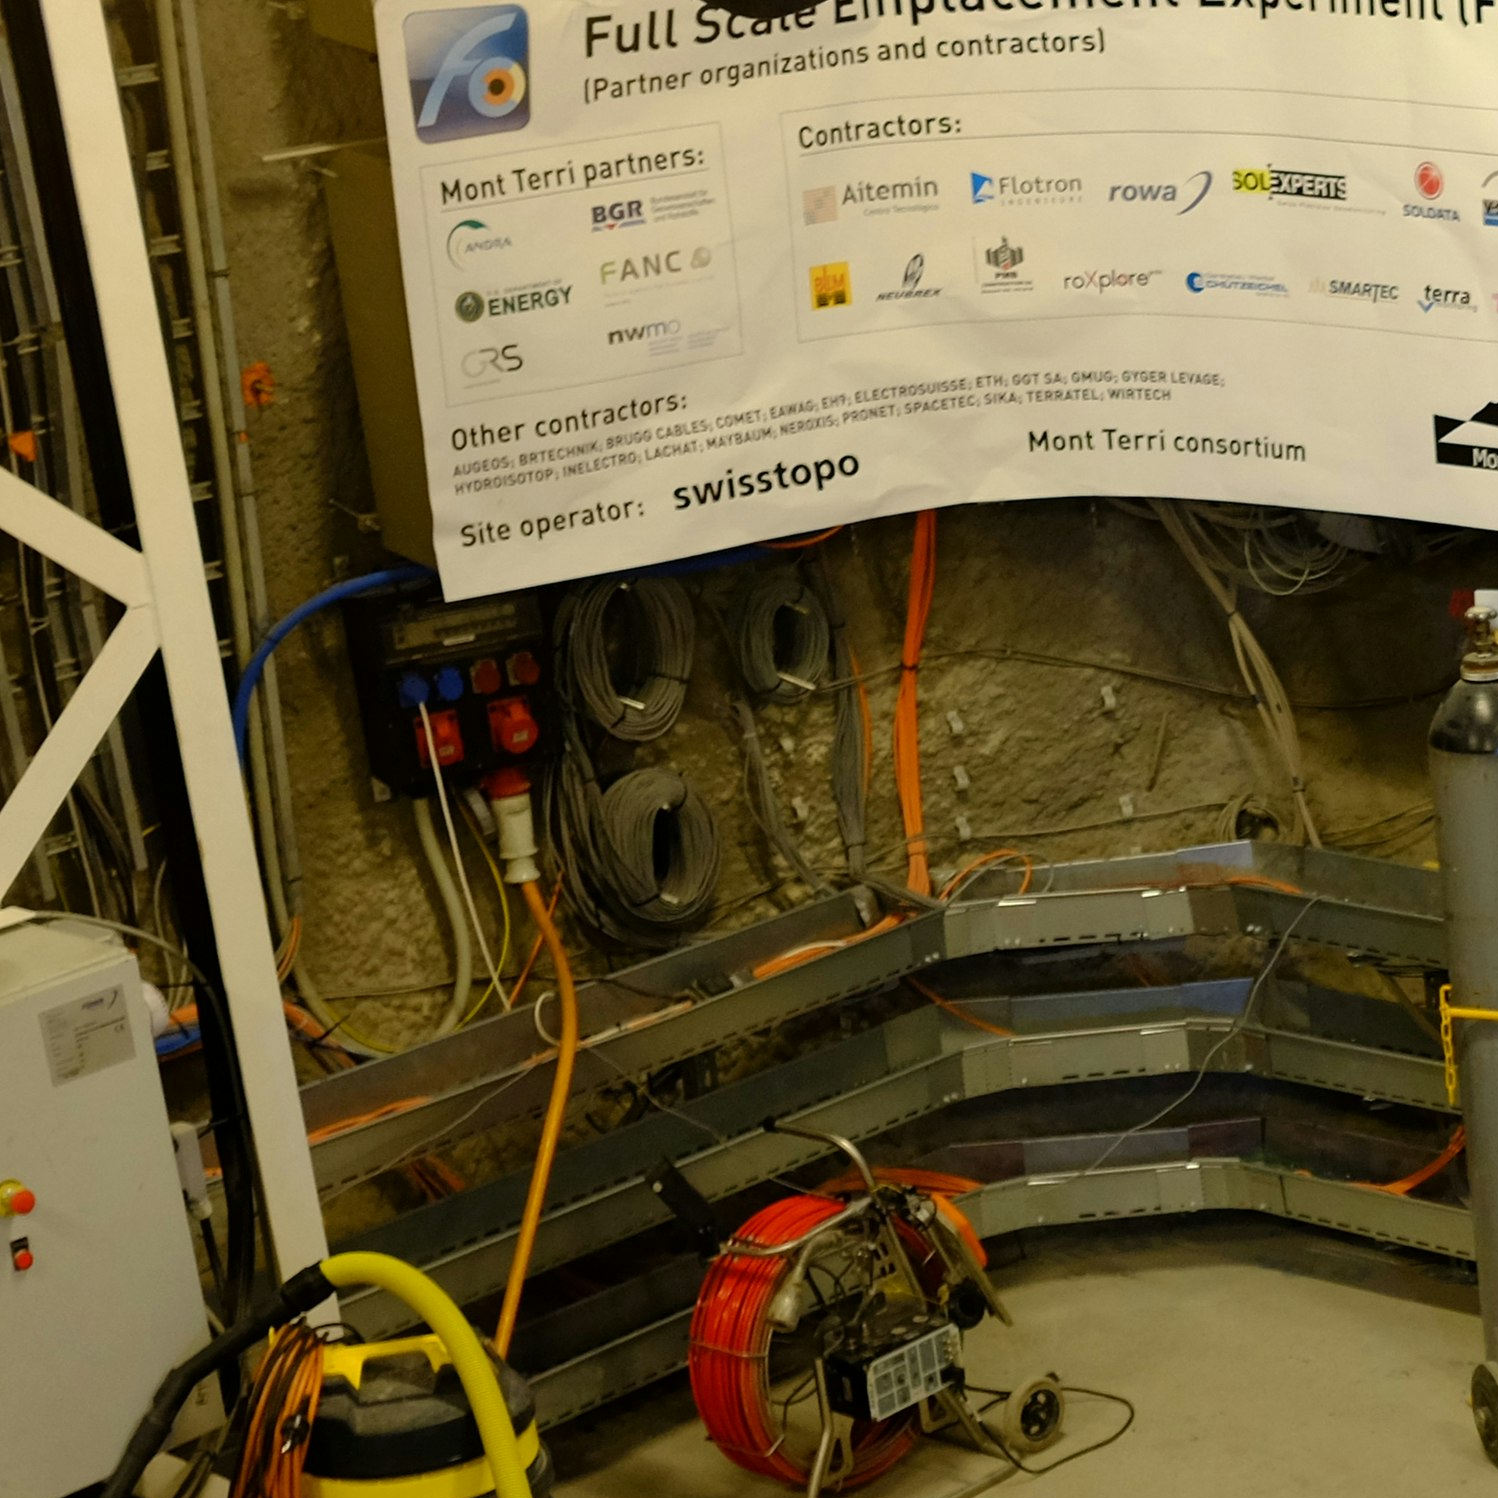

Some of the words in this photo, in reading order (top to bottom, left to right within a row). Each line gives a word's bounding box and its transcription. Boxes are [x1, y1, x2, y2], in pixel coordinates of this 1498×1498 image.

[585, 8, 677, 57] Full
[584, 70, 692, 104] (Partner
[700, 47, 868, 87] organizations
[877, 36, 925, 61] and
[937, 28, 1105, 59] contractors)
[799, 115, 962, 149] Contractors:
[441, 174, 505, 205] Mont
[512, 161, 575, 193] Terri
[583, 148, 705, 188] partners:
[842, 176, 939, 205] Aitemin
[1000, 176, 1082, 195] Flotron
[1233, 170, 1347, 200] SOLEXPERTS
[1108, 184, 1177, 202] rowa
[592, 200, 643, 225] BGR
[600, 250, 682, 285] FANC
[488, 285, 573, 317] ENERGY
[1329, 279, 1399, 303] SMARTEC
[1424, 284, 1471, 304] terra
[608, 319, 682, 345] nwmo
[1107, 388, 1171, 402] WIRTECH
[452, 421, 526, 451] Other
[535, 393, 688, 437] contractors:
[461, 521, 511, 547] Site
[520, 500, 645, 539] operator:
[673, 454, 860, 511] swisstopo
[1029, 430, 1095, 452] Mont
[1102, 429, 1165, 451] Terri
[1174, 434, 1306, 462] consortium
